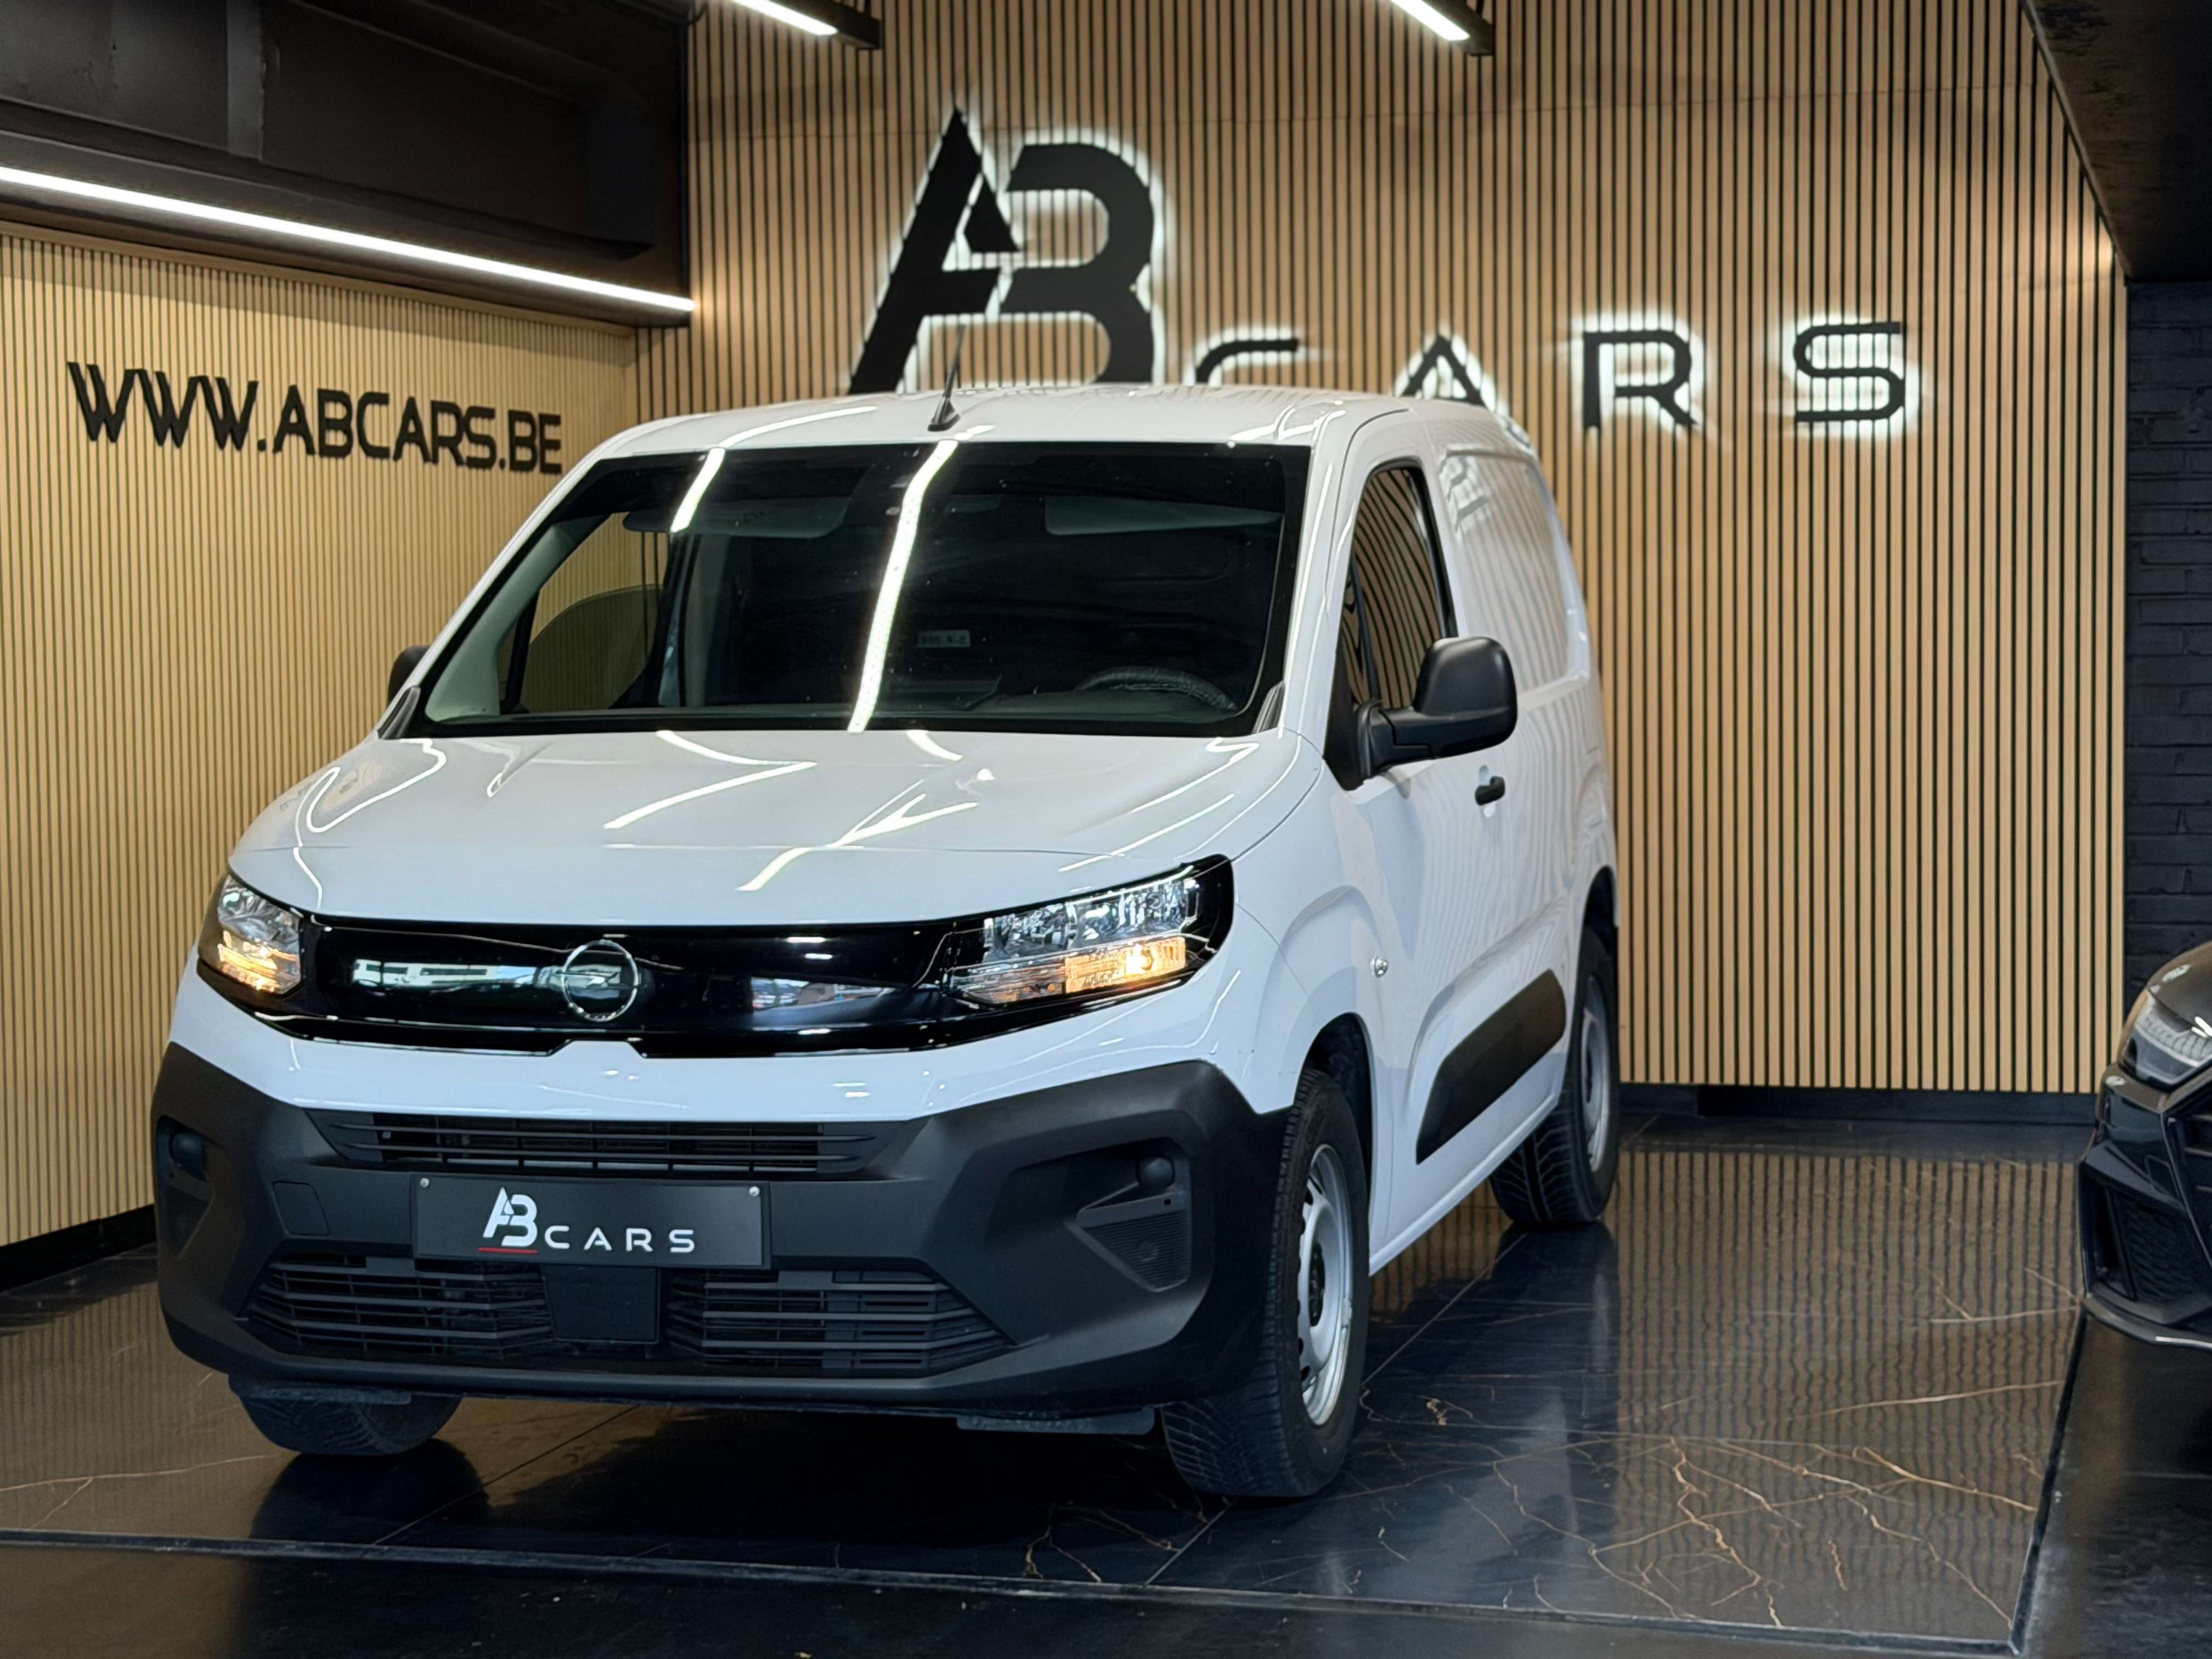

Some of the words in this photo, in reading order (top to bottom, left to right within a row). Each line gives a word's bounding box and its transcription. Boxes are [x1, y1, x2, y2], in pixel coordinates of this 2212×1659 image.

[848, 105, 1154, 394] AB
[66, 361, 563, 475] WWW.ABCARS.BE
[483, 1187, 538, 1247] AB
[544, 1225, 695, 1253] CARS
